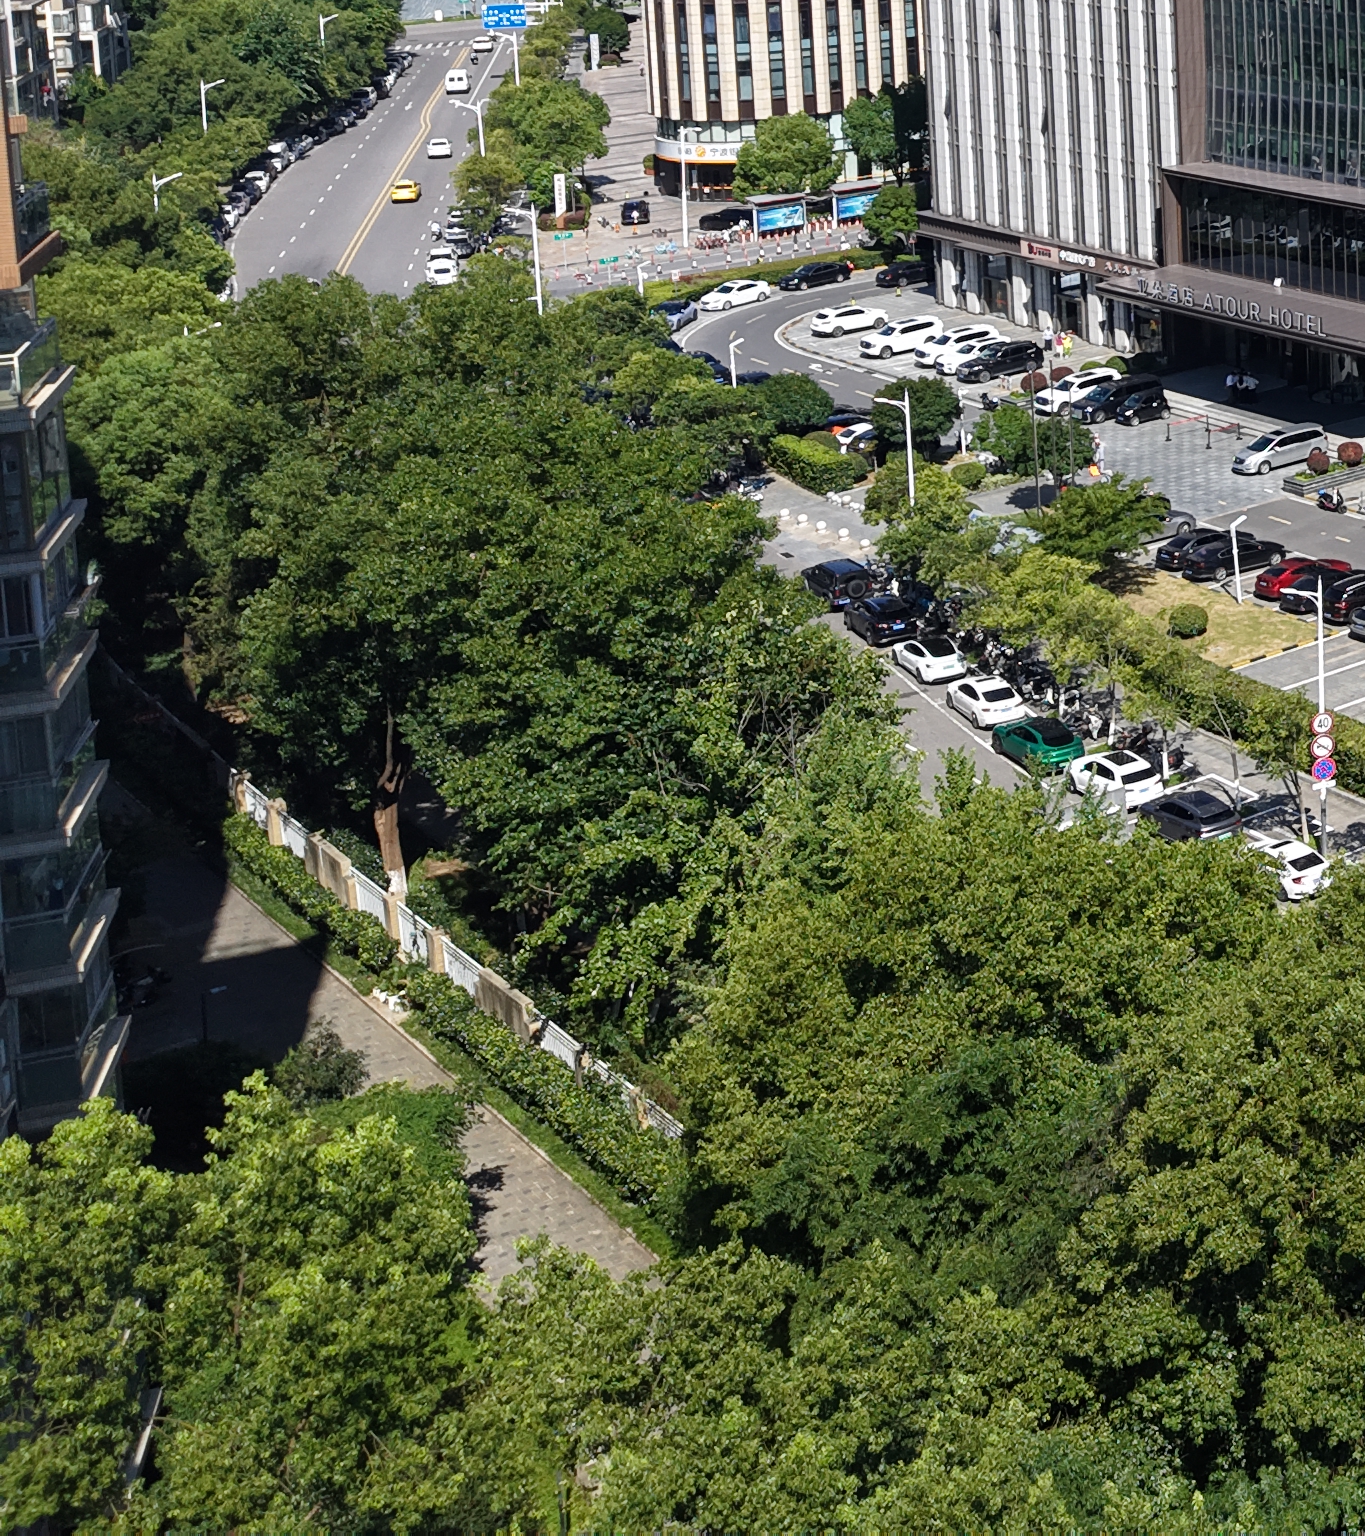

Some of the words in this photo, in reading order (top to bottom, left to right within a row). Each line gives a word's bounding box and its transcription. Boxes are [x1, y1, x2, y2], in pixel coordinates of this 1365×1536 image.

[1136, 276, 1195, 307] 亚朵酒店
[1203, 293, 1261, 322] ATOUR
[1269, 305, 1327, 338] HOTEL
[1317, 717, 1329, 729] 40
